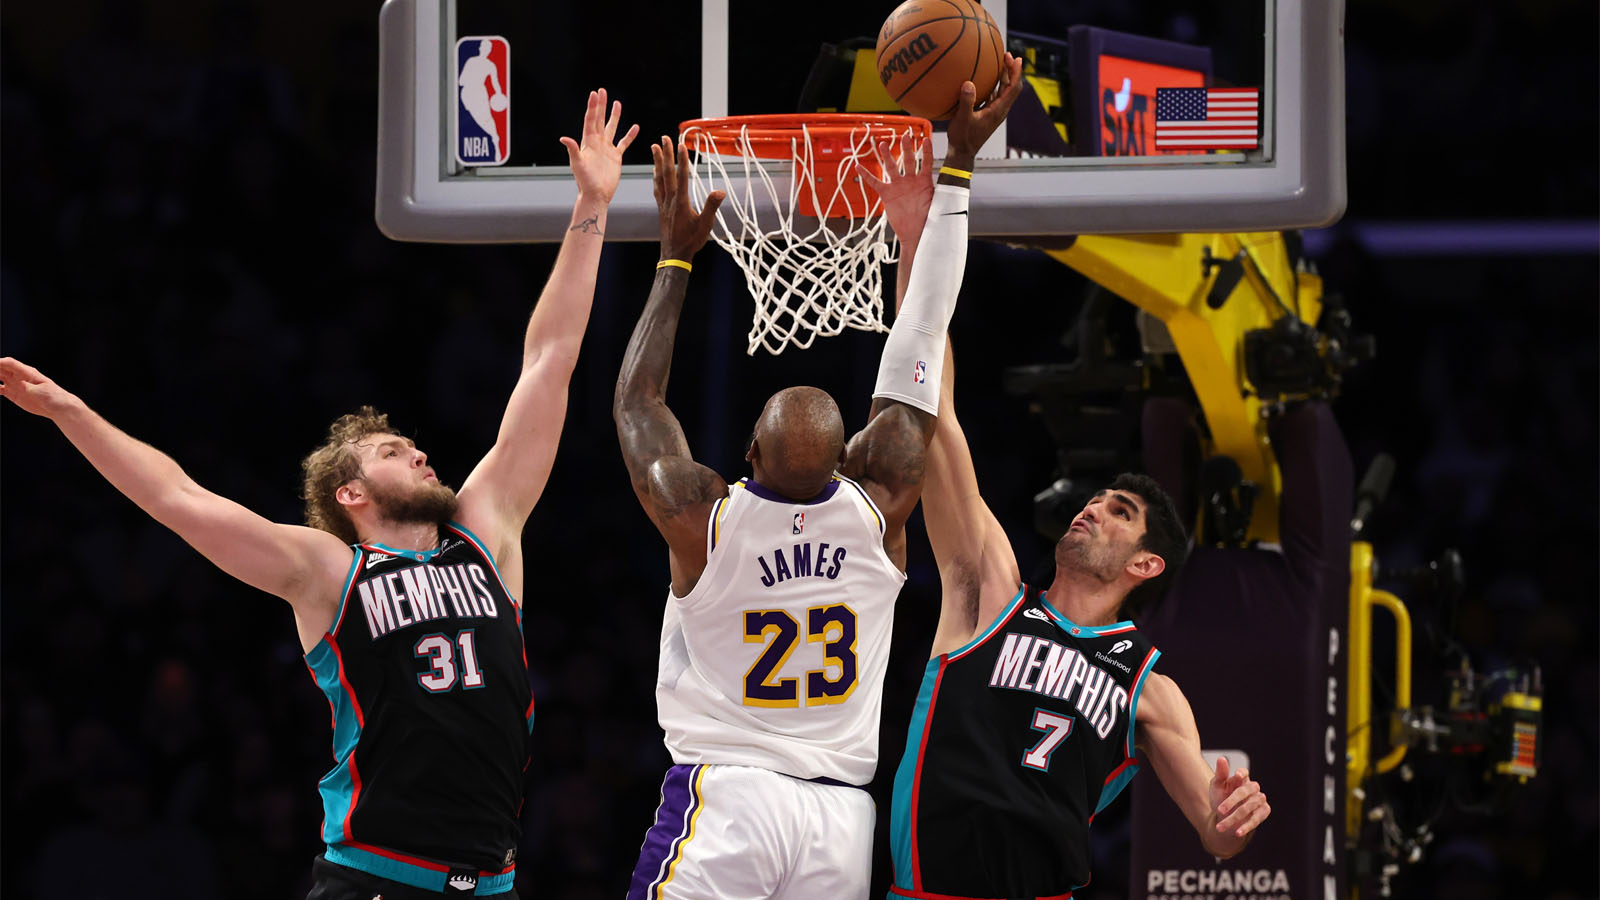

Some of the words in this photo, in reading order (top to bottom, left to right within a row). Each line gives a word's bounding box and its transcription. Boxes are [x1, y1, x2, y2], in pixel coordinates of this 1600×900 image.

[464, 137, 489, 157] NBA
[368, 552, 389, 563] NIKE
[758, 542, 847, 588] JAMES
[357, 563, 498, 641] MEMPHIS
[1029, 607, 1050, 621] NIKE
[413, 628, 486, 694] 31
[743, 602, 859, 709] 23
[1094, 651, 1131, 674] Robinhood
[988, 632, 1129, 741] MEMPHIS
[1021, 706, 1076, 773] 7
[1147, 869, 1290, 893] PECHANGA
